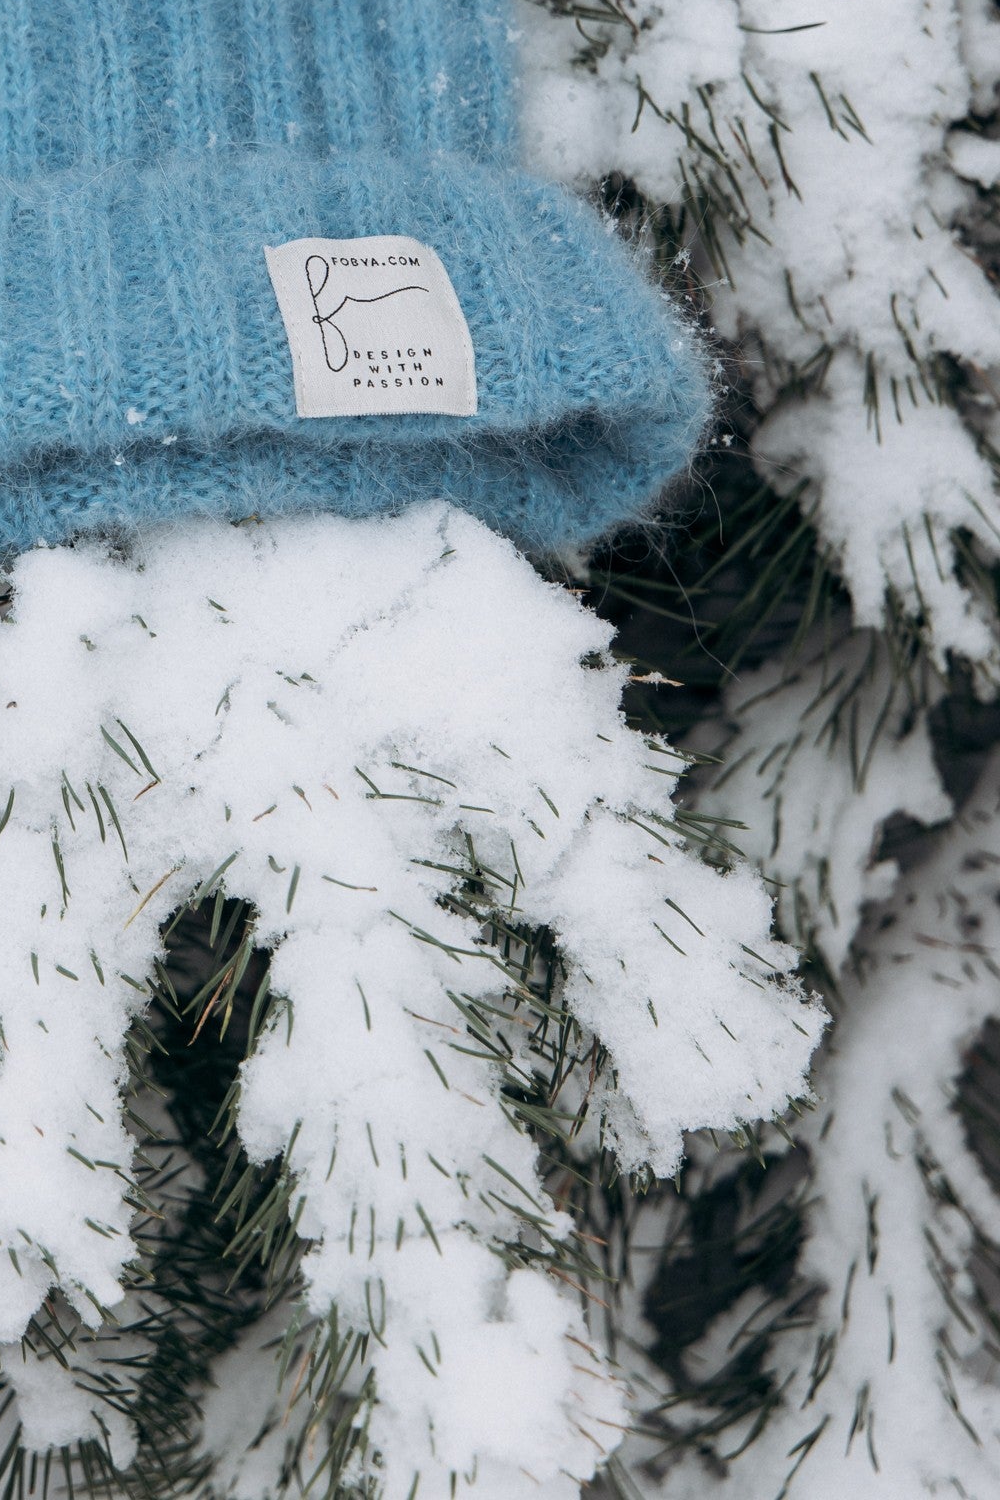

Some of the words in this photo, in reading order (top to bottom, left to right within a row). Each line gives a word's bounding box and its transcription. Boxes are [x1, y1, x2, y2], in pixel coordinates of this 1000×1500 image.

[331, 256, 421, 267] FOBYA.COM
[353, 348, 433, 360] DESIGN
[369, 363, 423, 373] WITH
[353, 378, 444, 388] PASSION
